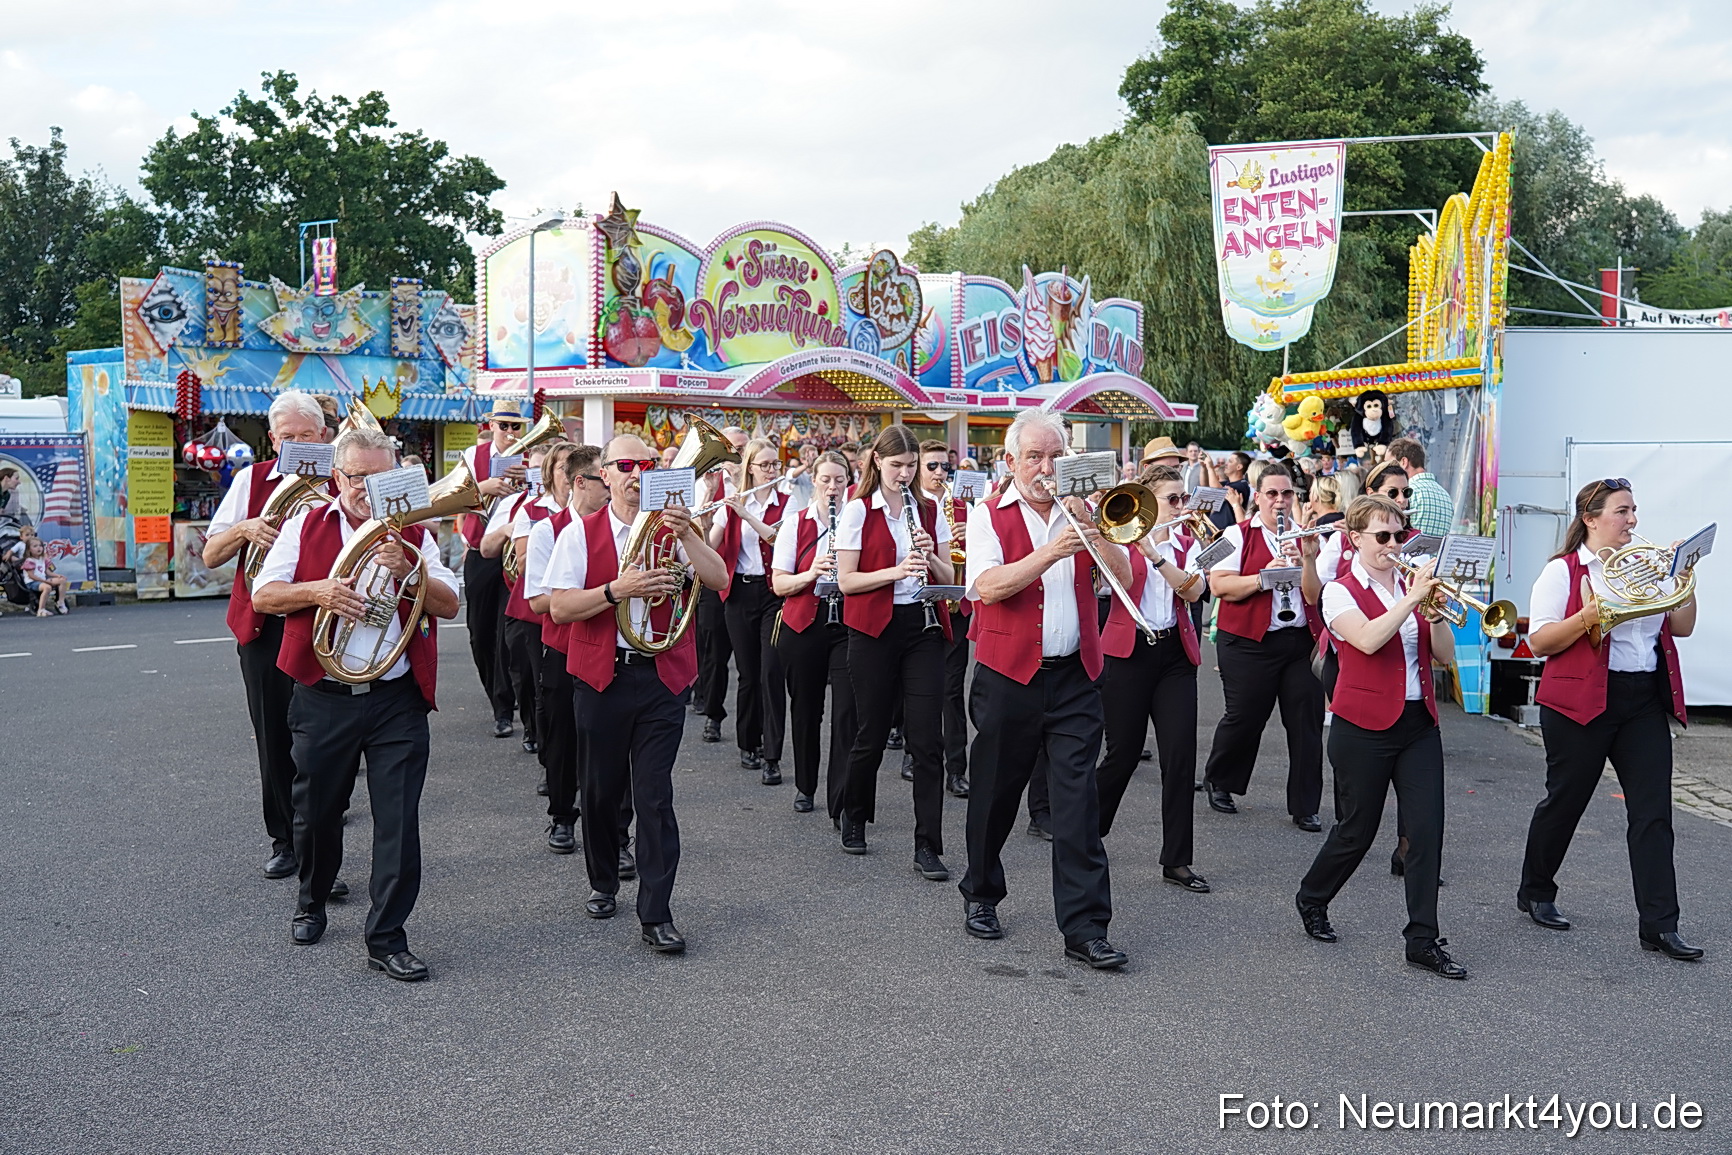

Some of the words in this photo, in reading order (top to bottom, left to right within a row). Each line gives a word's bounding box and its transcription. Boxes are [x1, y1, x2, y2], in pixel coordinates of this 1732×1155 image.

[1268, 162, 1334, 188] Lustiges
[1223, 187, 1328, 226] ENTEN-
[1221, 218, 1337, 261] ANGELN
[742, 239, 809, 288] Süsse
[689, 280, 848, 351] Versuchung
[1641, 311, 1663, 324] Auf
[961, 312, 1021, 368] EIS
[1092, 322, 1144, 378] BAR
[575, 377, 628, 386] Schokofrüchte
[678, 378, 707, 387] Popcorn
[780, 358, 819, 375] Gebrannte
[820, 354, 841, 364] Nüsse
[850, 356, 873, 370] immer
[875, 363, 897, 381] frisch!
[1314, 375, 1379, 391] LUSTIGE
[1384, 369, 1452, 384] ANGELEI
